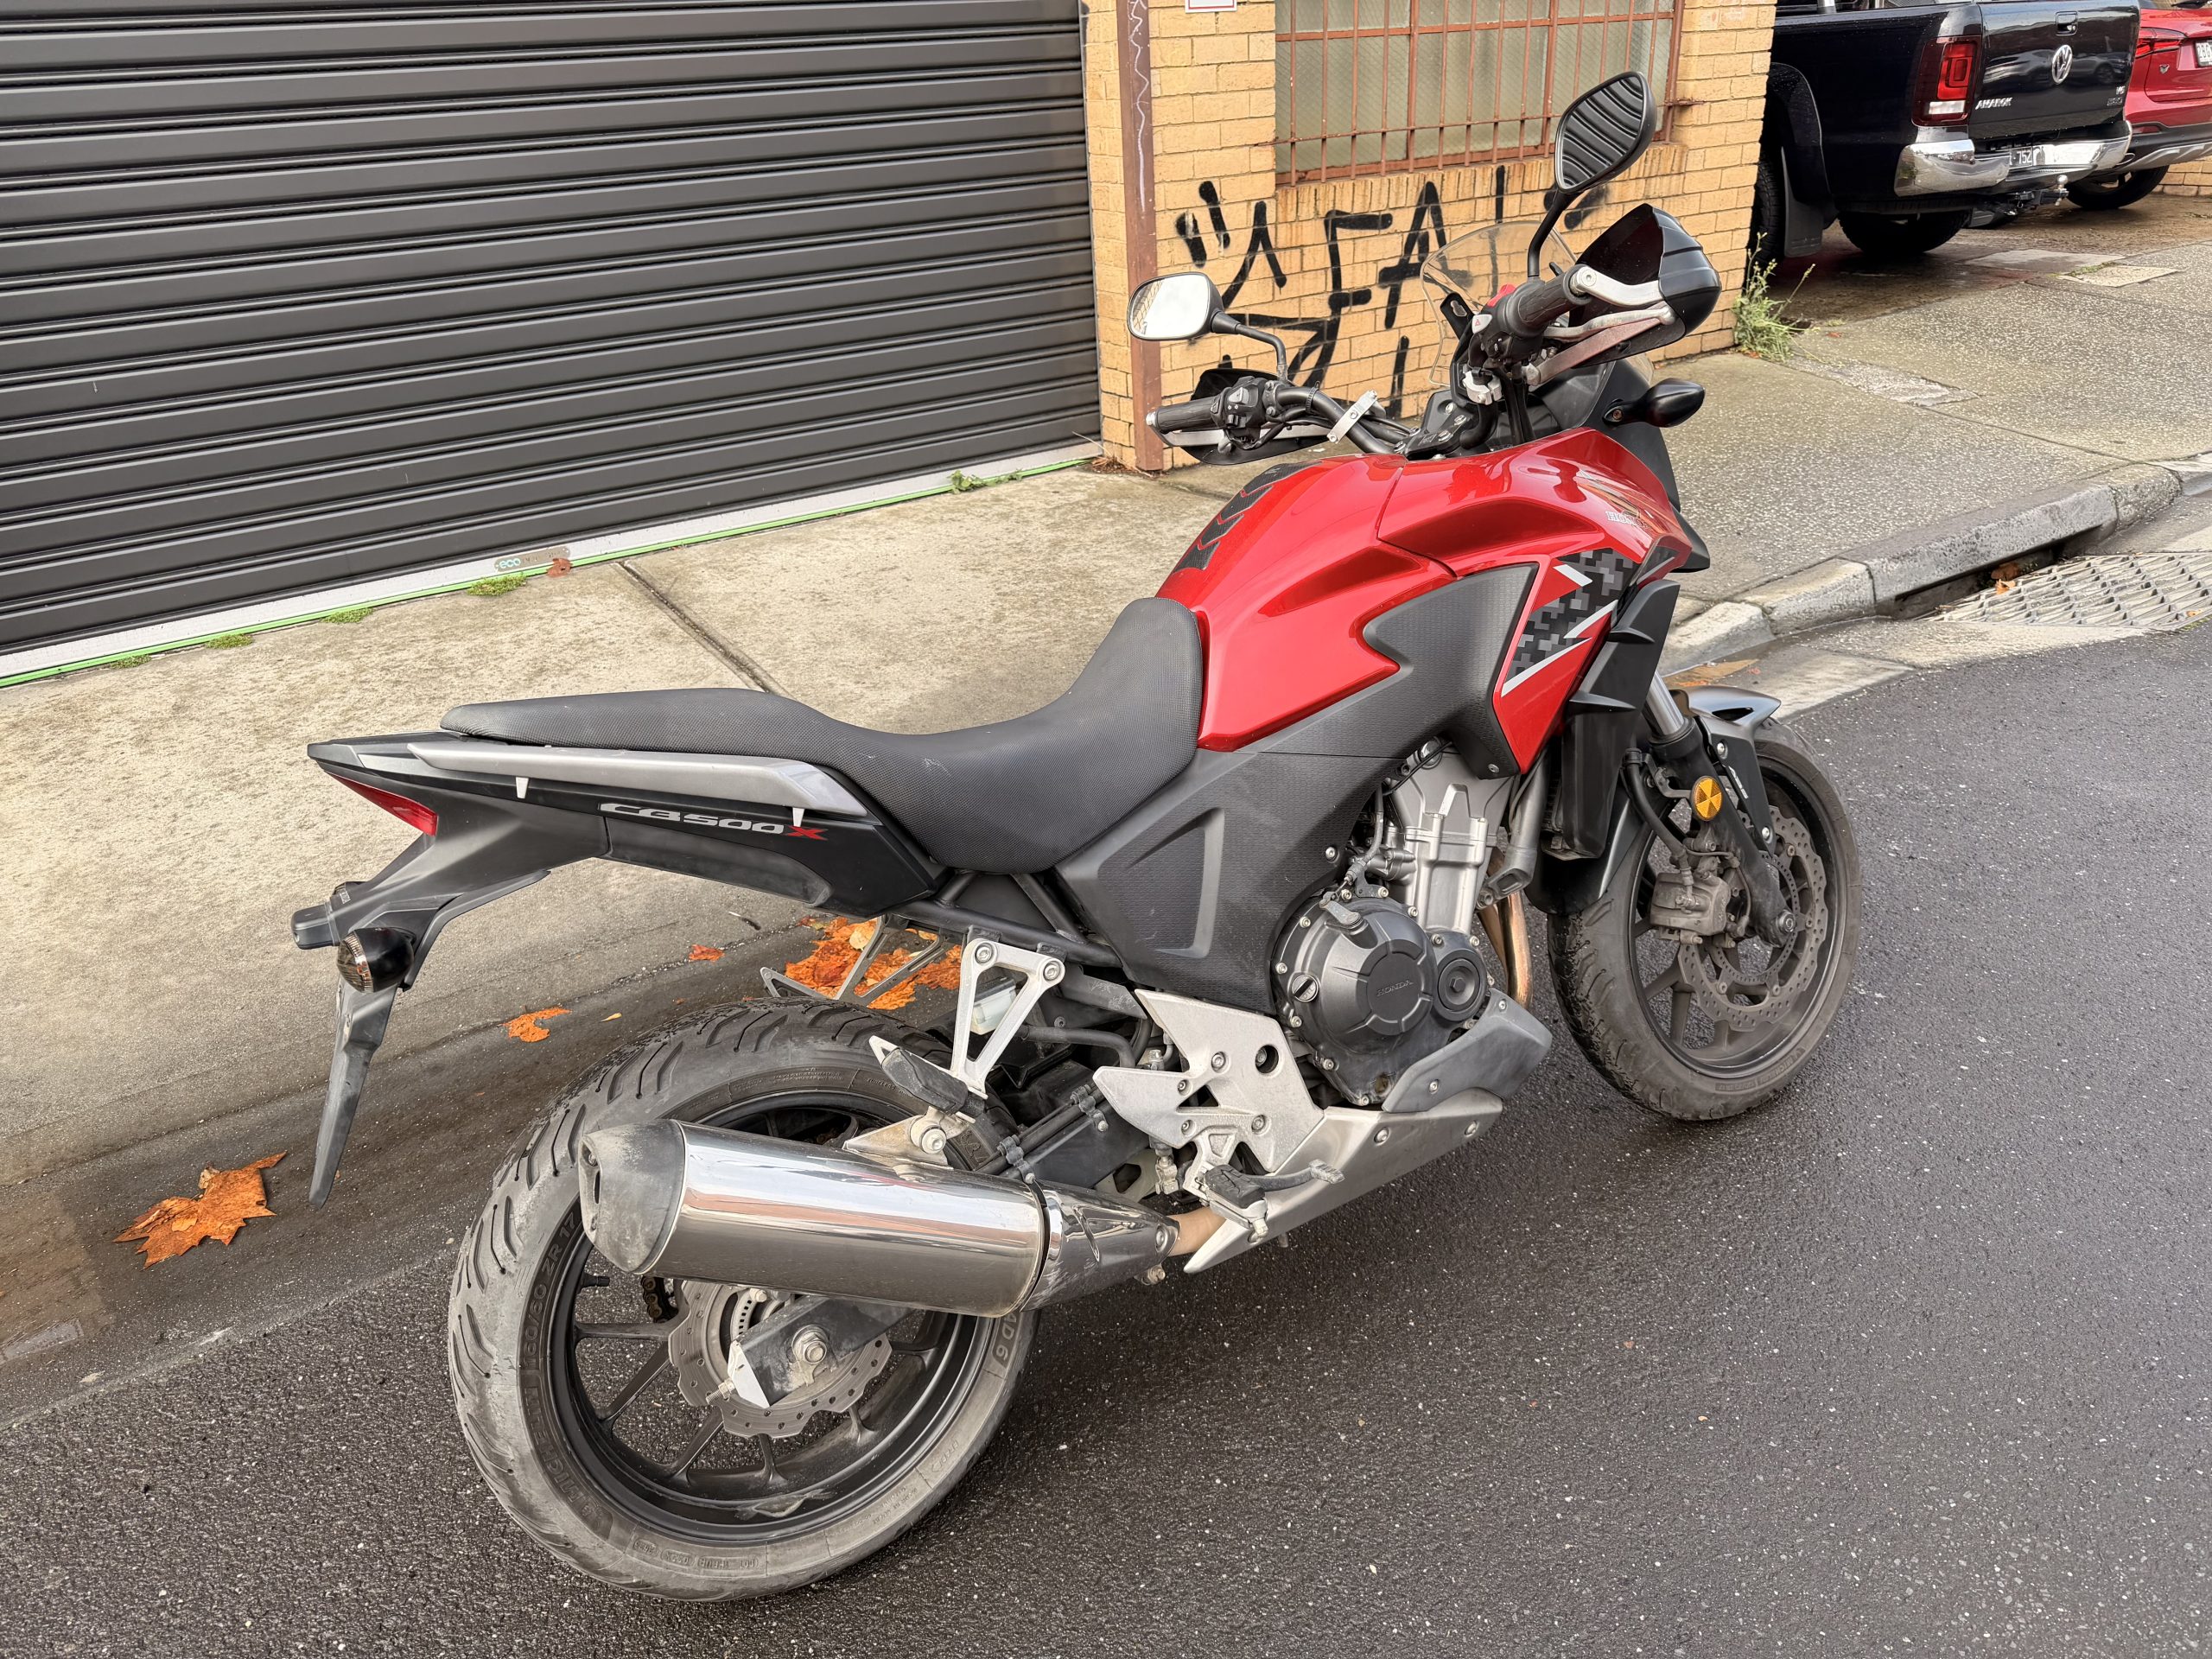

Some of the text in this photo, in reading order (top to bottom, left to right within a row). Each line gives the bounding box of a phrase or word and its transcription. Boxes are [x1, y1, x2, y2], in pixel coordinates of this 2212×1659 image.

[499, 557, 521, 569] eco
[597, 802, 829, 842] CB500X
[1376, 979, 1414, 997] HONDA
[522, 1211, 575, 1369] 160/60 ZR 17
[996, 1344, 1008, 1361] 6
[524, 1387, 583, 1503] MICHELIN
